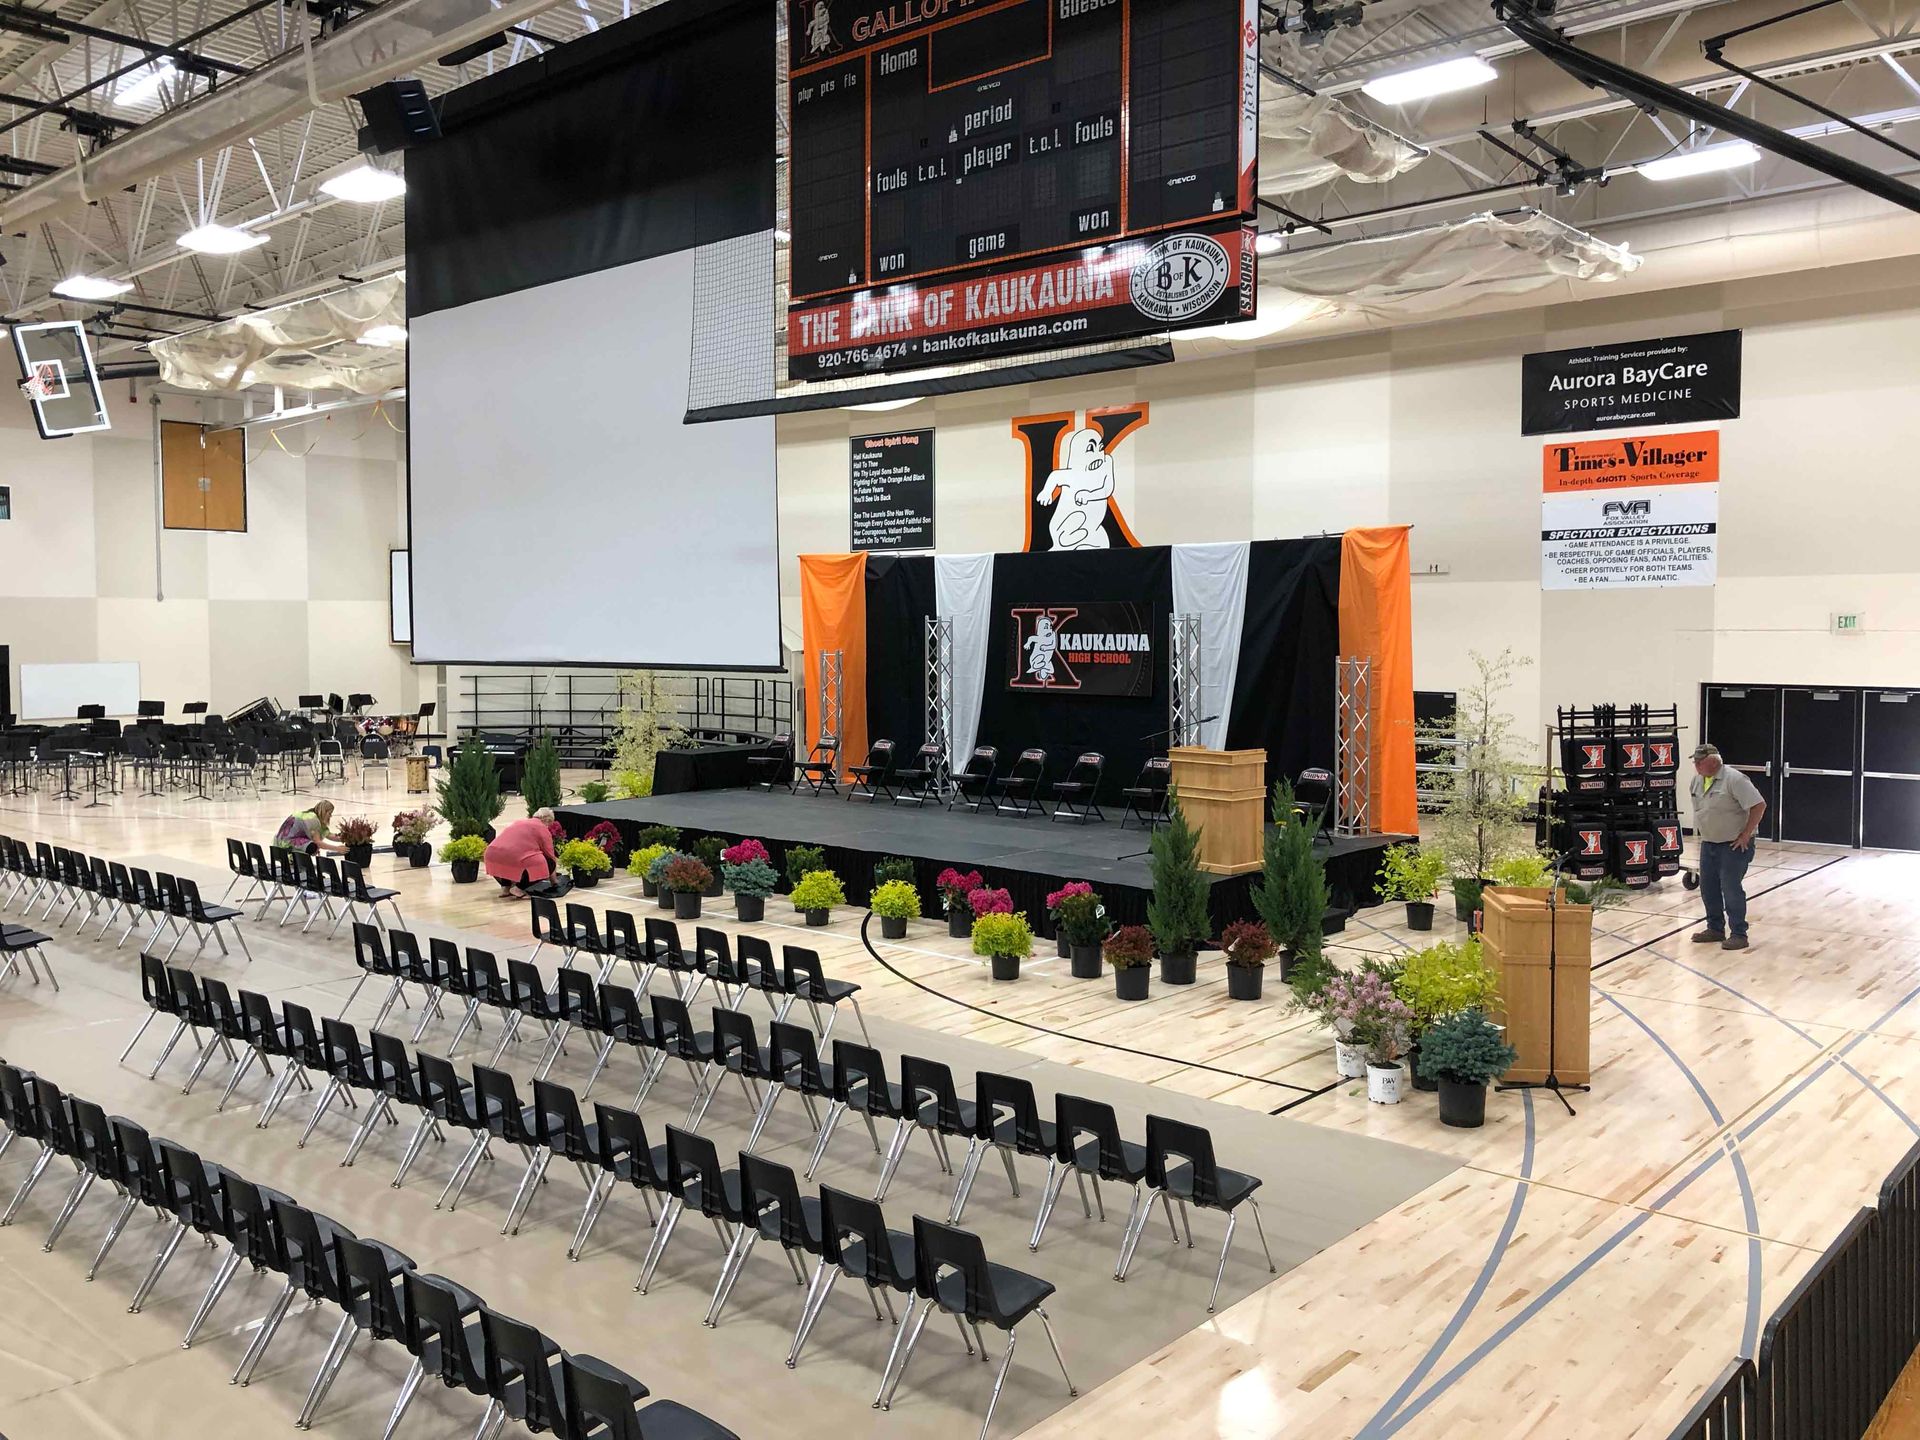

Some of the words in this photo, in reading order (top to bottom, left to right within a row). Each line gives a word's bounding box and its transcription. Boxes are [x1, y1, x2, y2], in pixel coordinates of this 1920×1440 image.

[880, 48, 917, 76] Home
[798, 88, 814, 104] plyr
[821, 79, 835, 97] pts
[844, 73, 857, 88] fls
[964, 98, 1012, 136] period
[1075, 116, 1114, 144] fouls
[964, 142, 1012, 175] player
[877, 168, 908, 193] fouls
[1079, 212, 1109, 233] won
[969, 232, 1006, 259] game
[1173, 240, 1183, 251] OF
[1185, 239, 1223, 266] KAUKAUNA
[879, 253, 905, 272] won
[1155, 261, 1173, 290] B
[1173, 271, 1183, 281] OF
[1182, 256, 1203, 289] K
[1241, 253, 1254, 312] GHOSTS
[799, 309, 840, 348] THE
[850, 300, 913, 340] BANK
[923, 289, 955, 328] OF
[965, 263, 1115, 321] KAUKAUNA
[1182, 279, 1222, 313] WISCONSIN
[818, 343, 907, 368] 920-766-4674
[923, 316, 1088, 353] bankofkaukauna.com
[1568, 355, 1592, 365] Athletic
[1593, 352, 1619, 363] Training
[1620, 350, 1646, 360] Services
[1647, 346, 1677, 357] provided
[1677, 345, 1688, 355] by:
[1549, 371, 1616, 392] Aurora
[1623, 362, 1709, 387] BayCare
[1564, 395, 1614, 410] SPORTS
[1621, 387, 1692, 405] MEDICINE
[1595, 410, 1656, 422] aurorabaycare.com
[1553, 440, 1708, 473] Times-Villager
[1559, 477, 1593, 487] In-depth
[1596, 474, 1627, 483] GHOSTS
[1630, 472, 1657, 482] Sports
[1659, 470, 1700, 480] Coverage
[1602, 499, 1651, 516] FVA
[1549, 528, 1615, 540] SPECTATOR
[1617, 524, 1710, 537] EXPECTATIONS
[1589, 539, 1635, 547] ATTENDANCE
[1560, 550, 1602, 558] RESPECTFUL
[1615, 548, 1636, 556] GAME
[1592, 556, 1628, 564] OPPOSING
[1646, 564, 1666, 572] BOTH
[1838, 615, 1857, 629] EXIT
[1060, 633, 1150, 652] KAUKAUNA
[1068, 652, 1091, 663] HIGH
[1093, 652, 1131, 664] SCHOOL
